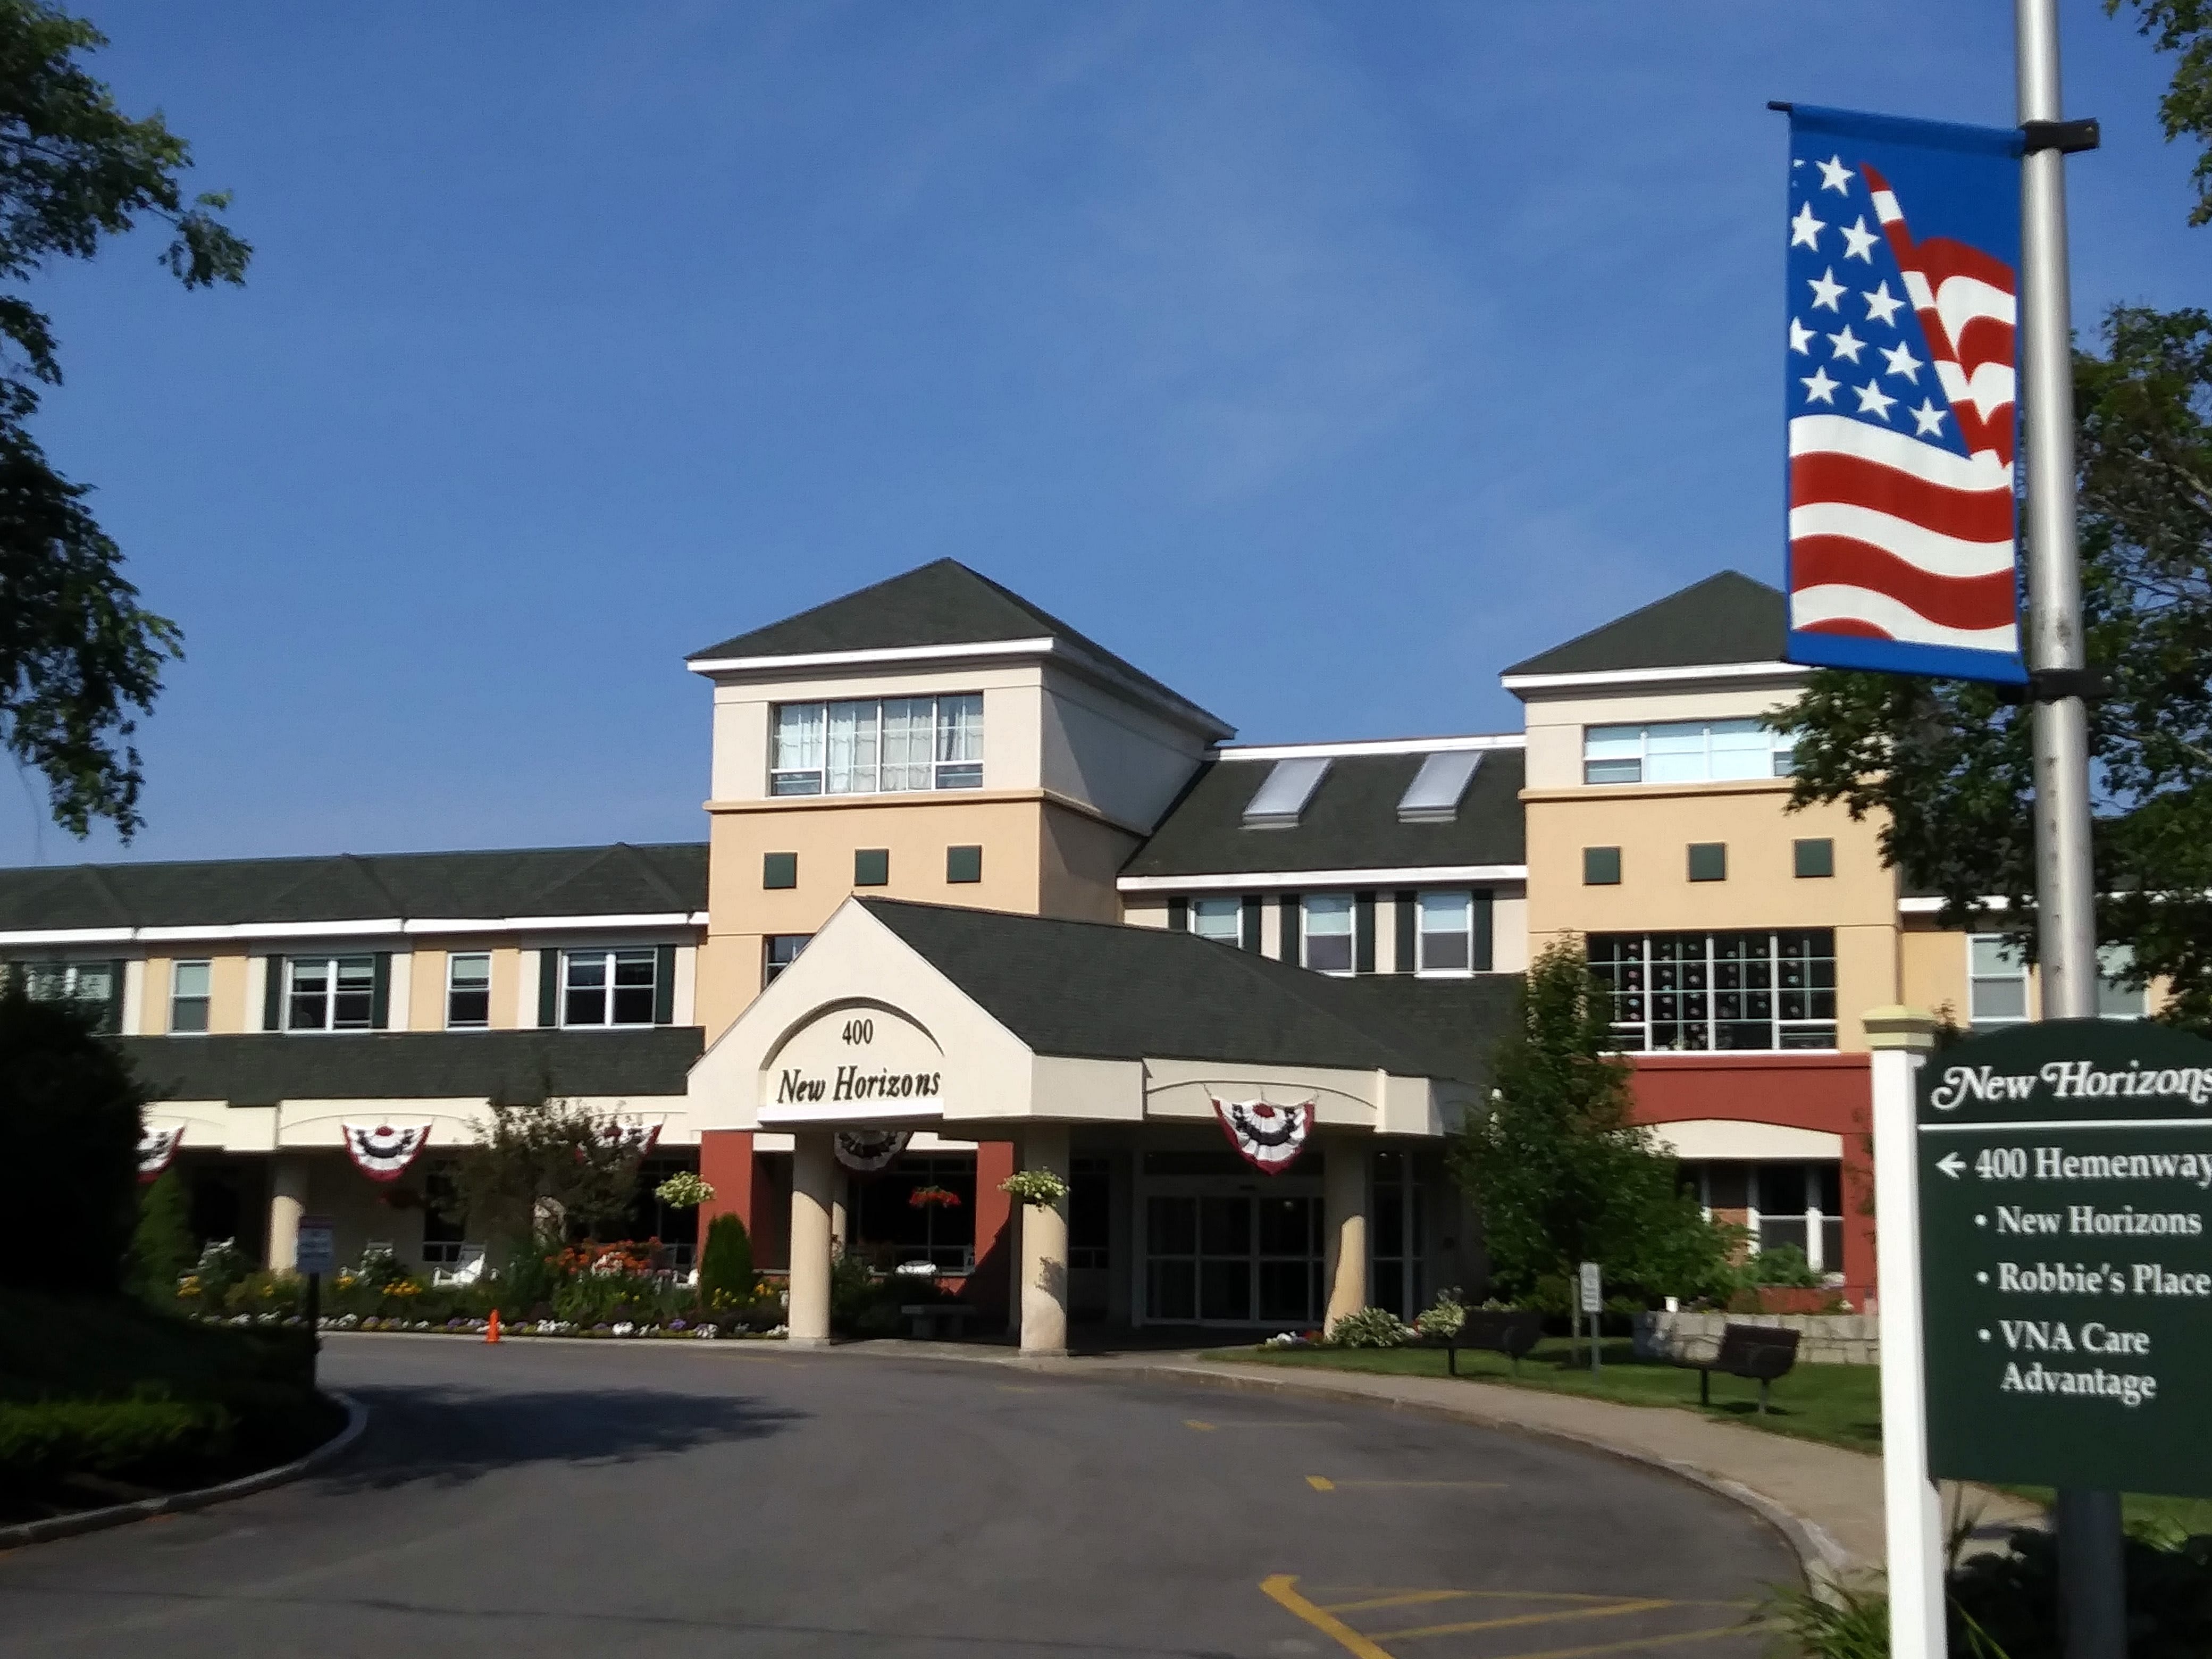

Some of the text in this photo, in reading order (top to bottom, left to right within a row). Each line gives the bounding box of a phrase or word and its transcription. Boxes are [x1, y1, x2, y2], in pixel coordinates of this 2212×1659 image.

[842, 1019, 874, 1045] 400
[776, 1065, 941, 1104] New Horizons
[1930, 1066, 2037, 1110] New
[1974, 1146, 2212, 1189] 400 Hemenway
[1995, 1205, 2203, 1235] New Horizons
[1996, 1262, 2211, 1295] Robbie's Place
[1998, 1320, 2150, 1354] VNA Care
[2000, 1362, 2157, 1406] Advantage
